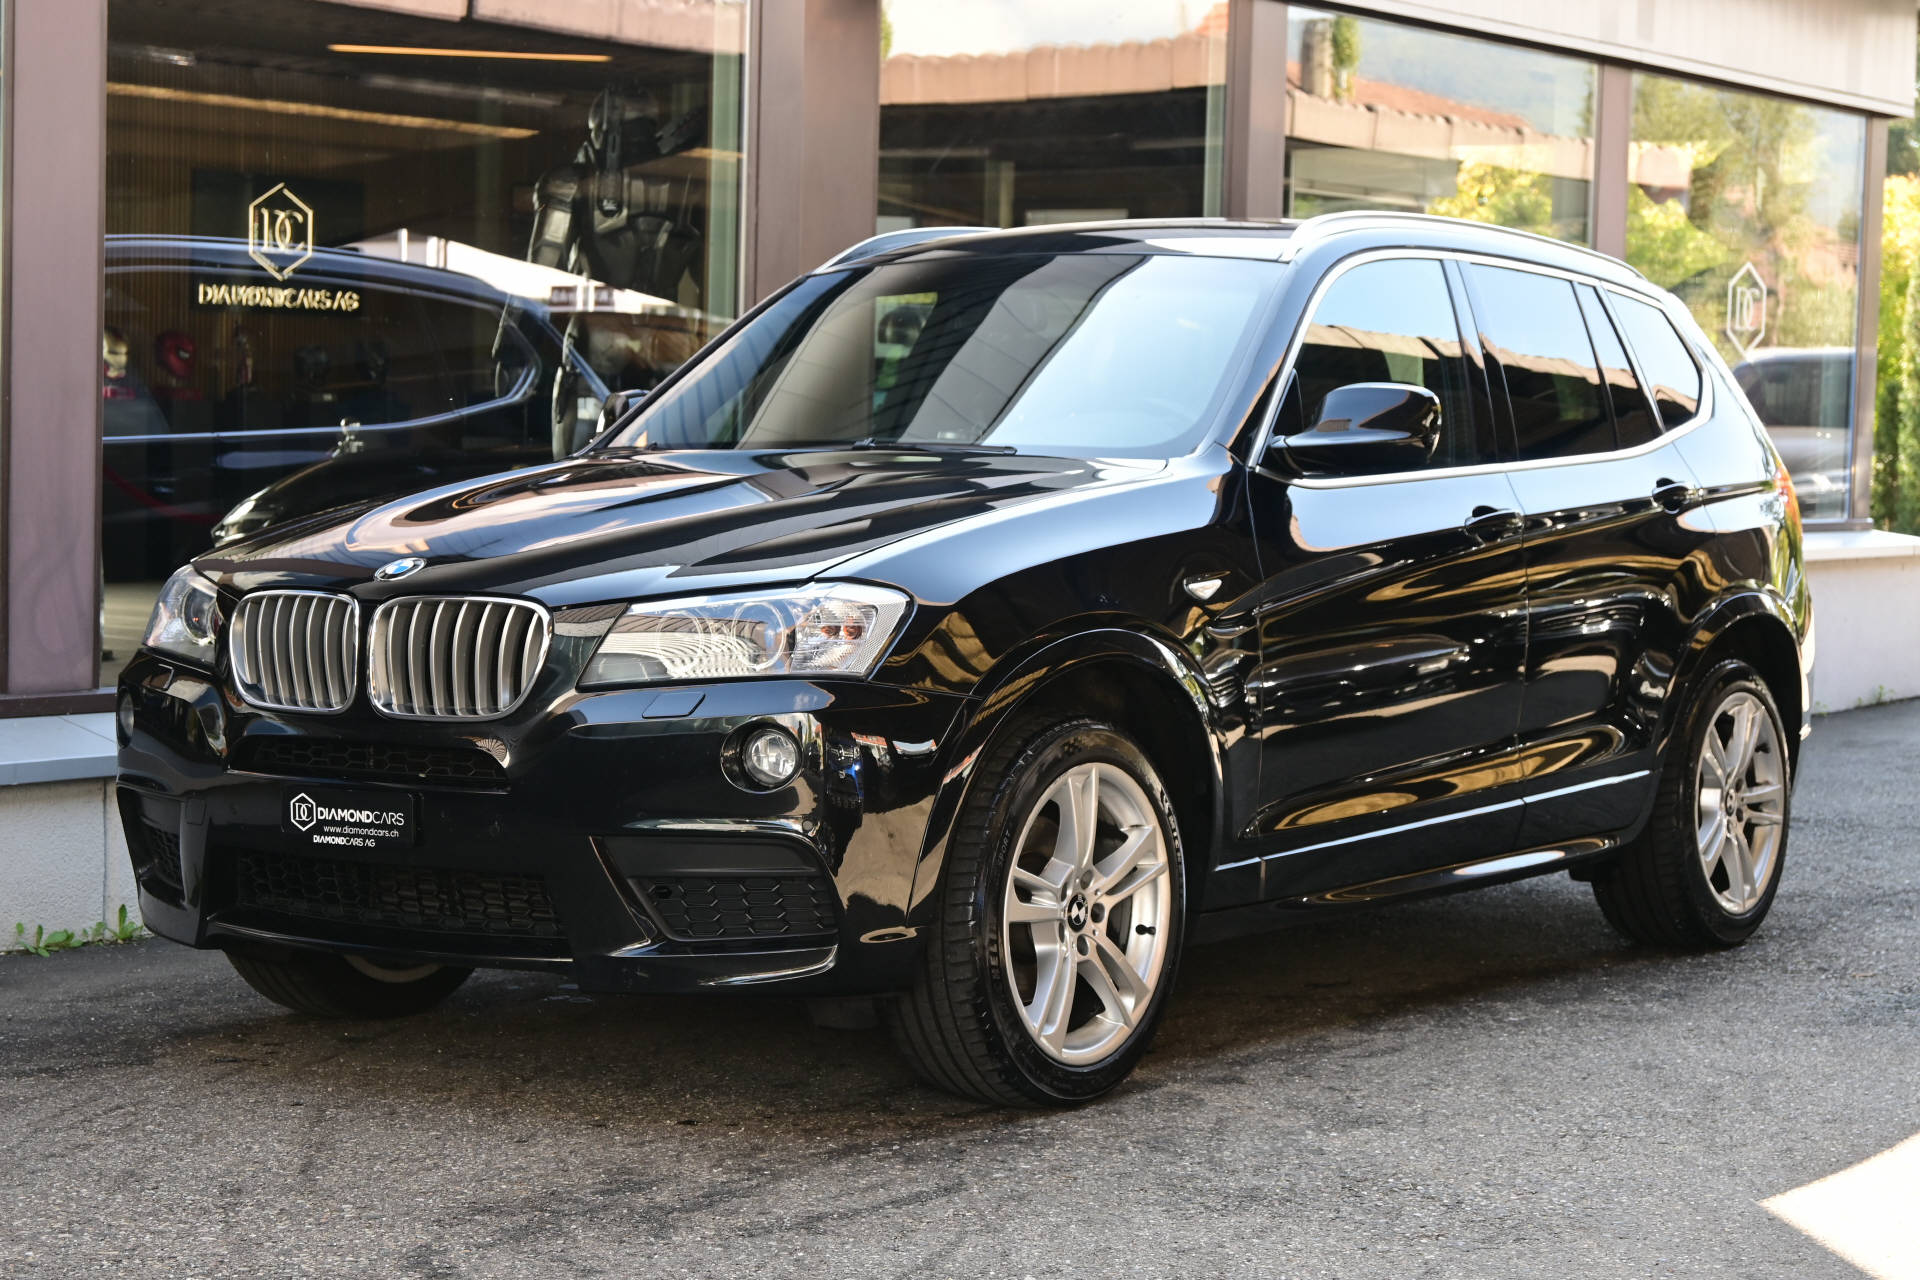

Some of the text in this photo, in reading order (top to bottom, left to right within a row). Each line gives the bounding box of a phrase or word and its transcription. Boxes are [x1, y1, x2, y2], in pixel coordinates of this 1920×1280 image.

[198, 283, 360, 312] DIAMONDCARS AG
[317, 807, 405, 826] DIAMONDCARS
[323, 825, 399, 838] www.diamondcars.ch
[313, 835, 376, 847] DIAMONDCARS AG
